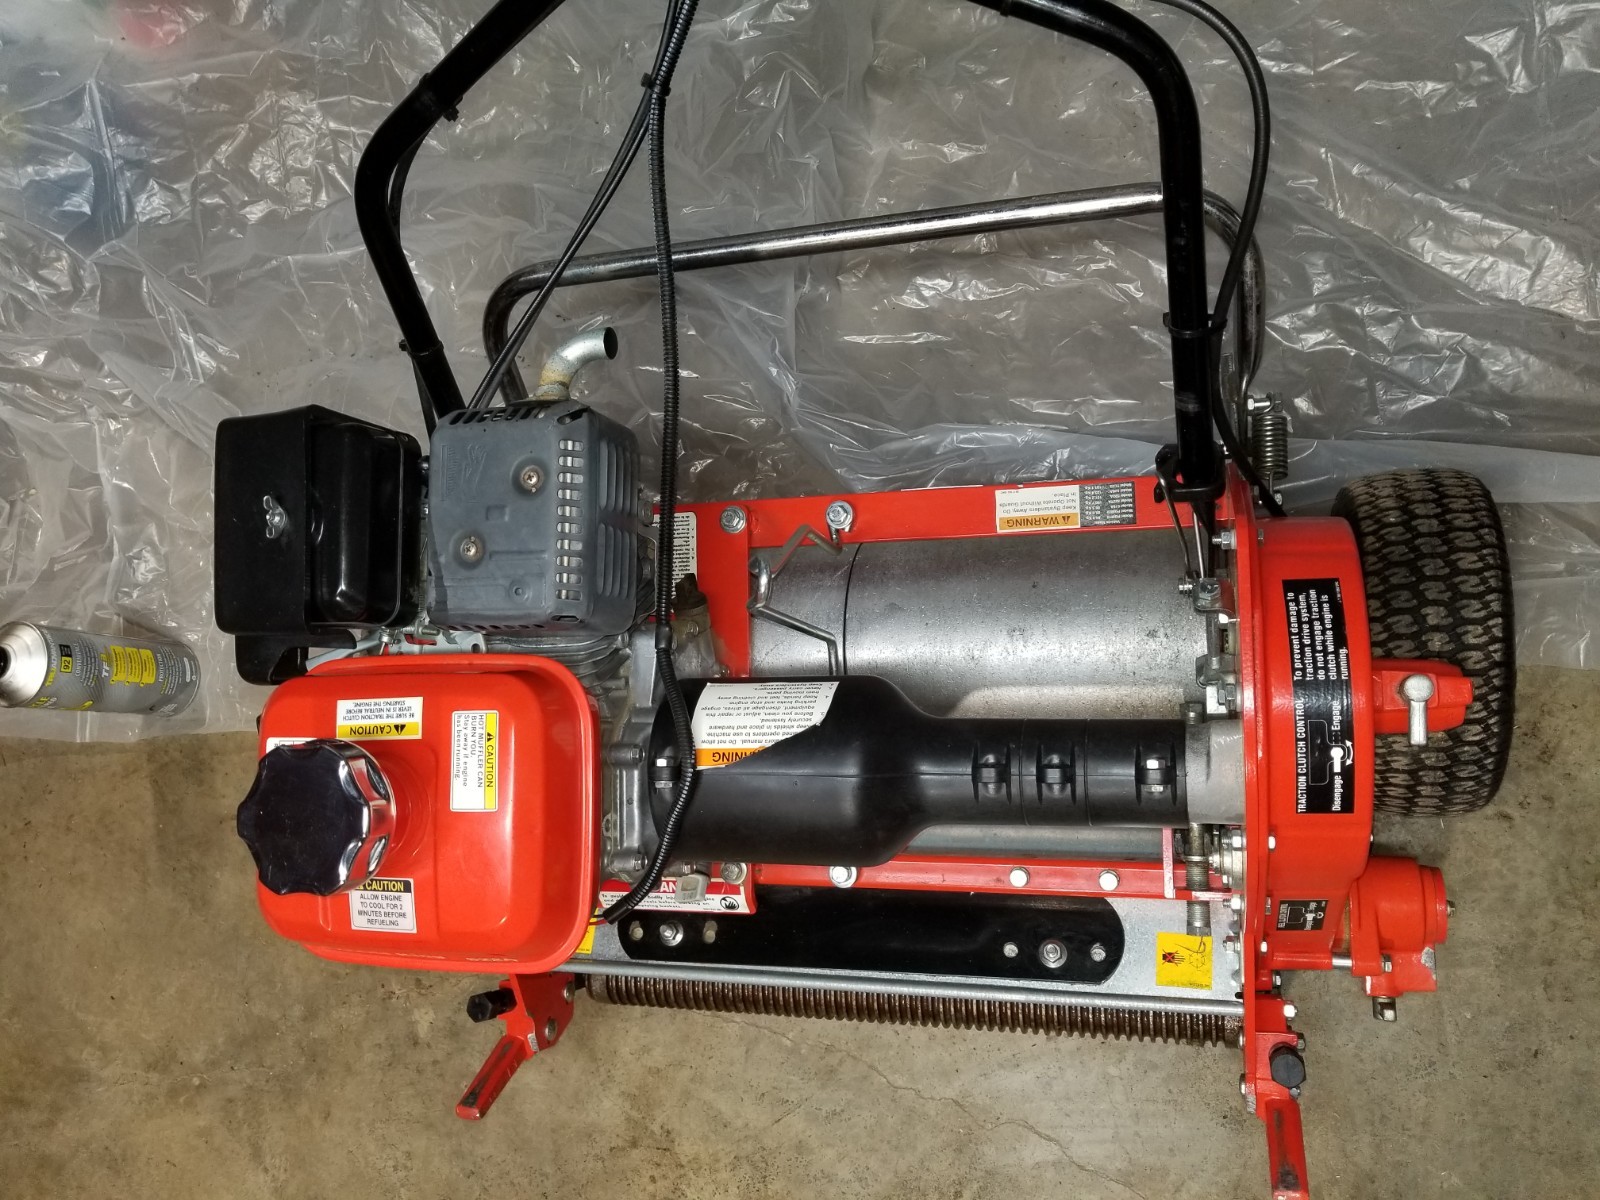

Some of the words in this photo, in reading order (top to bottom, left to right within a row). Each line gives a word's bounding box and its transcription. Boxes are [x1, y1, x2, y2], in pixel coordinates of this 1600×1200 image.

[1006, 516, 1060, 528] WARNING
[1288, 601, 1299, 633] damage
[1298, 592, 1310, 622] system,
[1308, 589, 1320, 619] traction
[1321, 603, 1333, 628] engine
[1300, 623, 1312, 645] drive
[1312, 620, 1324, 651] engage
[1324, 630, 1335, 652] while
[63, 659, 71, 670] 92
[1290, 635, 1303, 668] prevent
[1303, 646, 1314, 681] traction
[1315, 652, 1325, 667] not
[1338, 646, 1349, 680] running.
[1293, 670, 1303, 681] To
[1316, 669, 1326, 680] do
[1326, 654, 1337, 680] clutch
[1295, 697, 1306, 739] CONTROL
[1331, 700, 1342, 731] Engage
[350, 725, 392, 736] CAUTION
[1297, 741, 1306, 774] CLUTCH
[1297, 775, 1307, 813] TRACTION
[1331, 775, 1344, 811] Disengage
[365, 880, 404, 892] CAUTION
[357, 909, 383, 917] MINUTES
[366, 918, 399, 926] REFUELING
